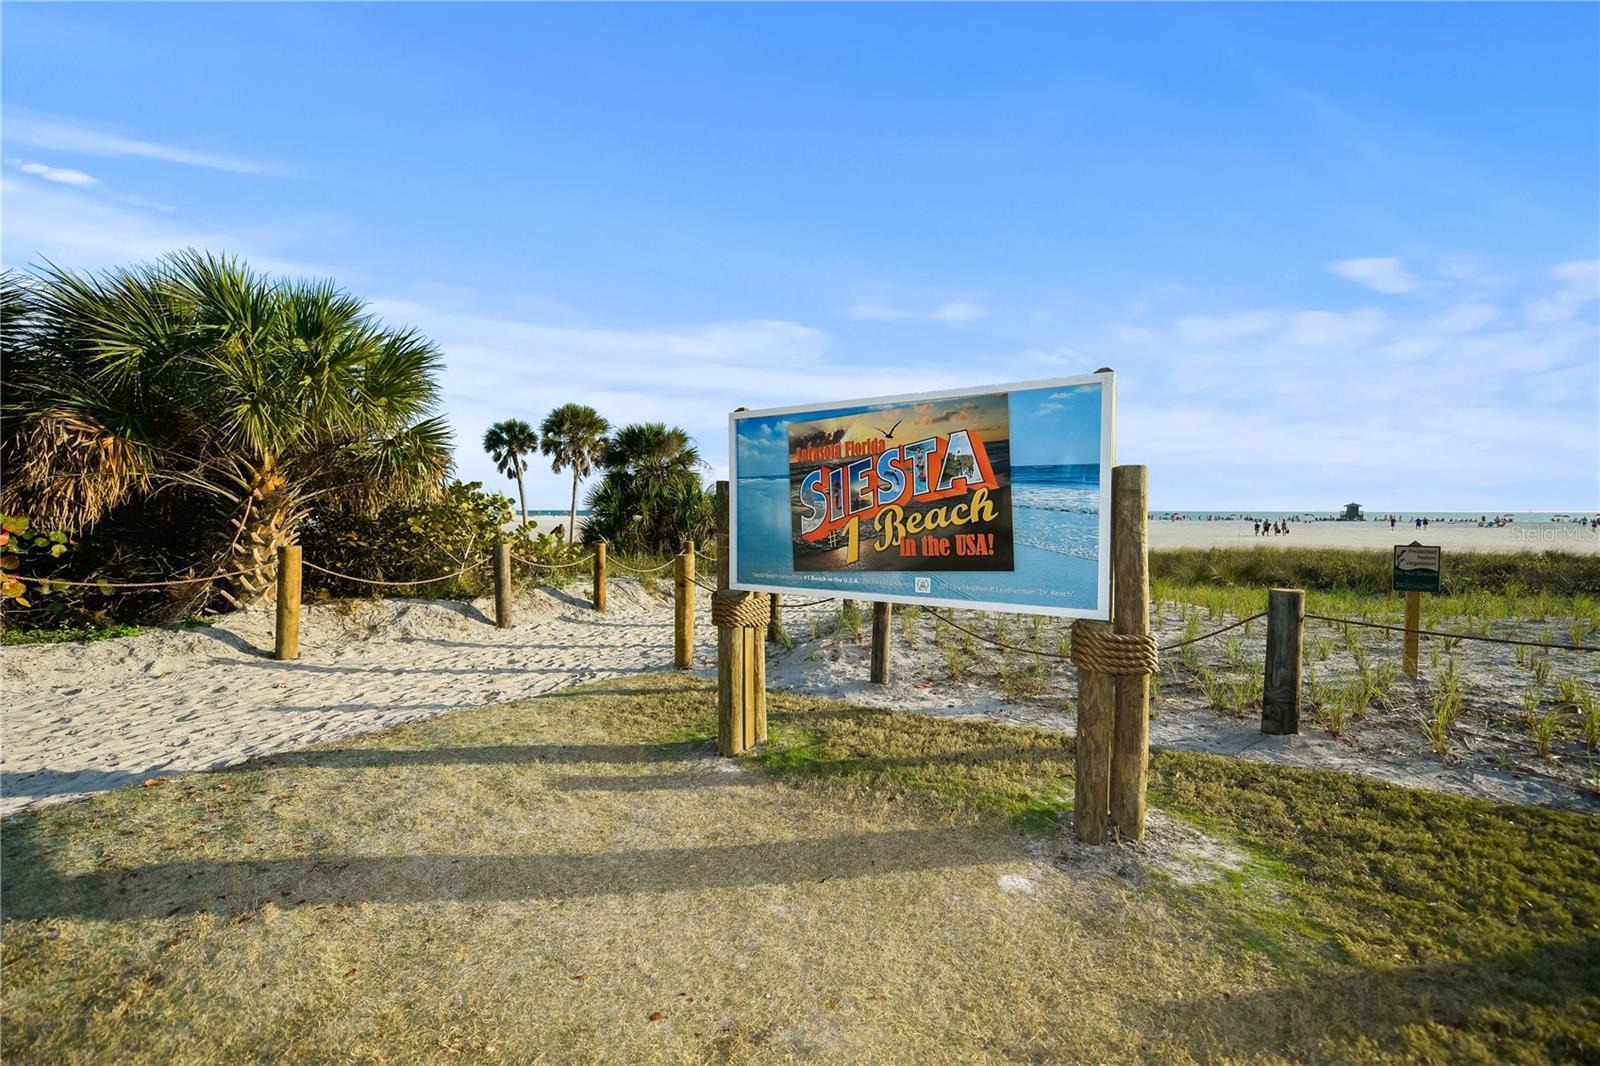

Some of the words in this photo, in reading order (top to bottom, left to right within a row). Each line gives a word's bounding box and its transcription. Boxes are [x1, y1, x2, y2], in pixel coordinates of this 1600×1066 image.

[795, 441, 842, 462] Sarasota
[845, 438, 886, 457] Florida
[800, 429, 991, 538] SIESTA
[873, 487, 999, 553] Beach
[921, 534, 951, 557] the
[955, 533, 995, 557] USA!
